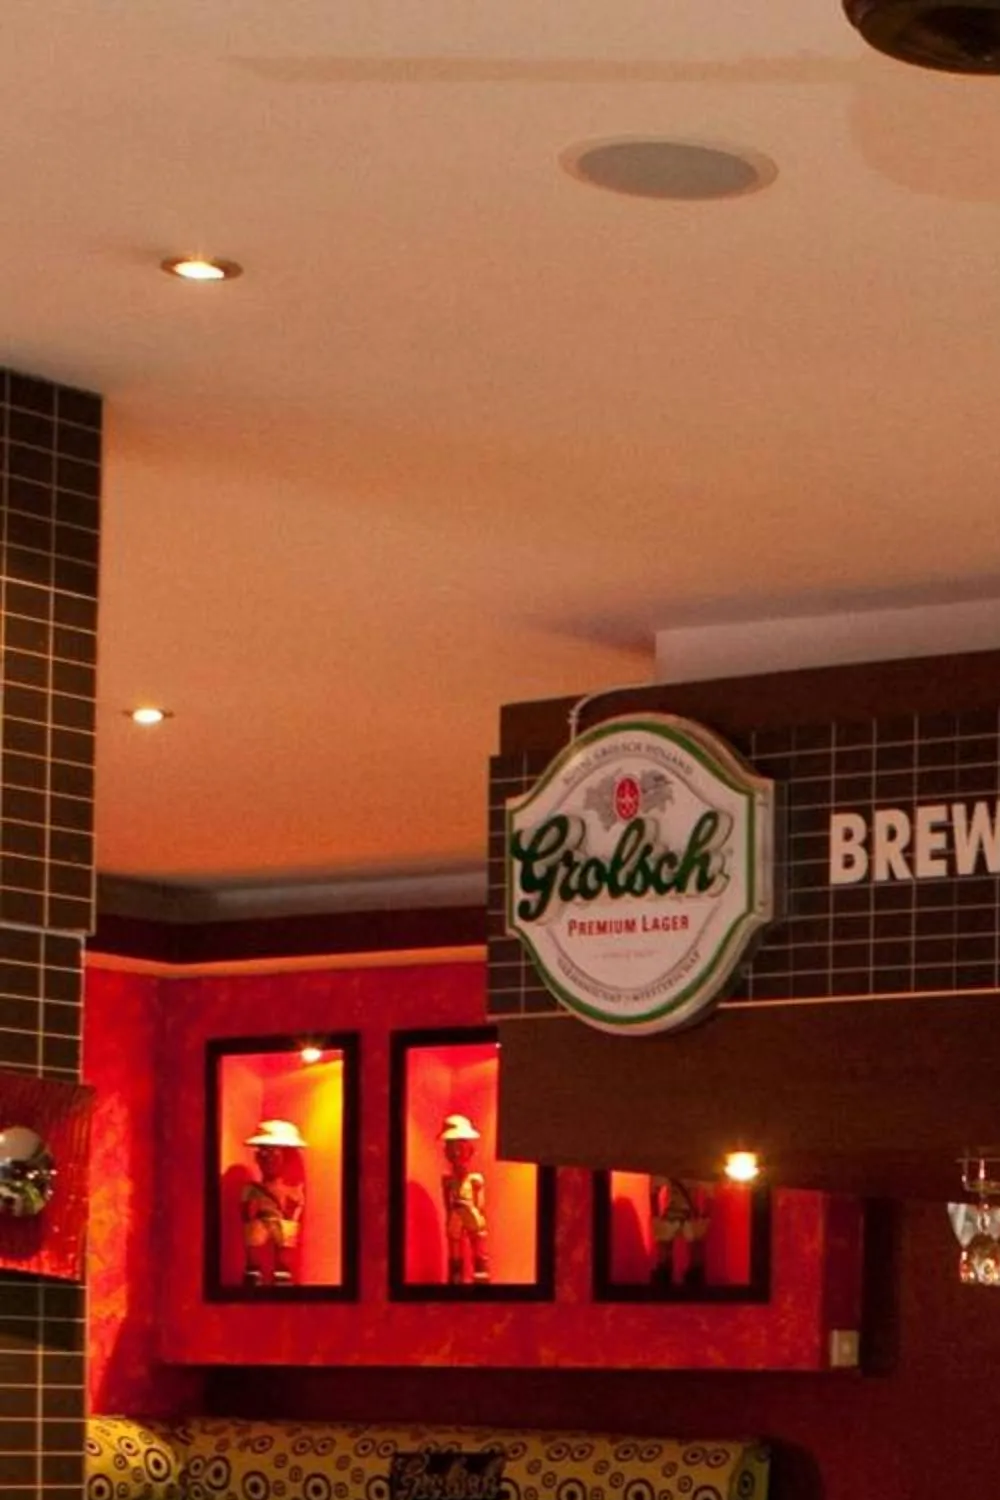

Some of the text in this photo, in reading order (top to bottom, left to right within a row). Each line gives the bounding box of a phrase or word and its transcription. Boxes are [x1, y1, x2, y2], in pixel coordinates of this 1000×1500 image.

[510, 811, 726, 922] Grolsch
[568, 914, 690, 937] PREMIUM LAGER
